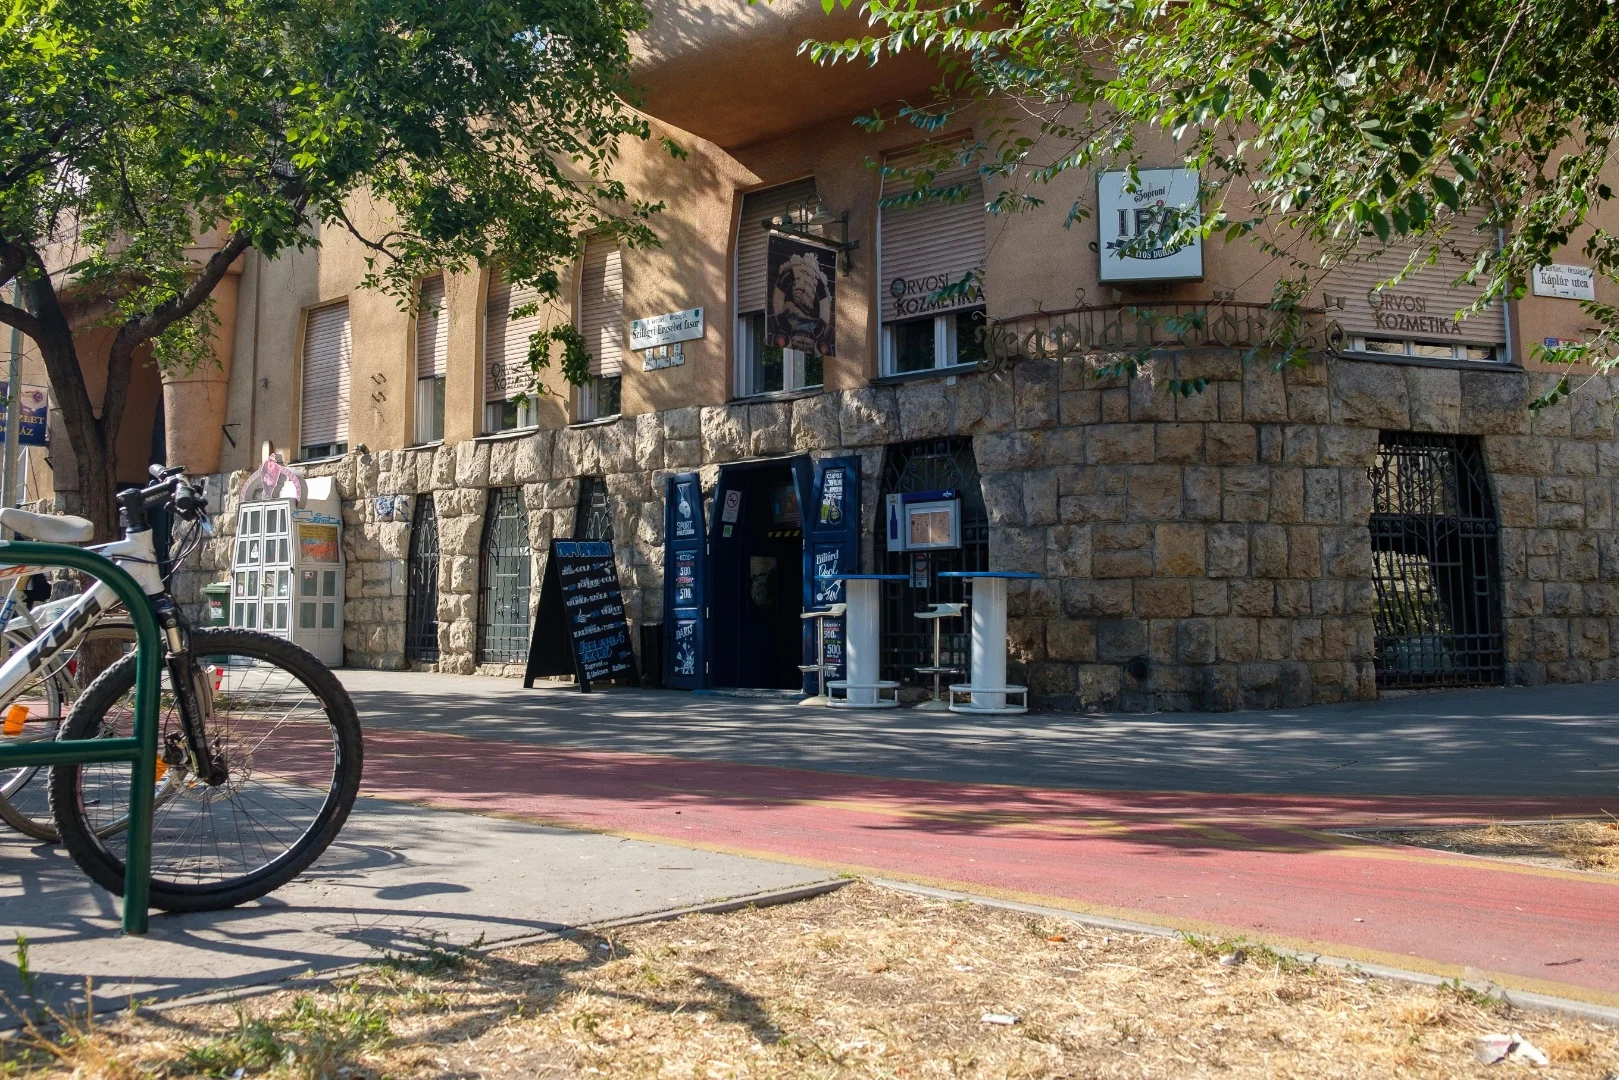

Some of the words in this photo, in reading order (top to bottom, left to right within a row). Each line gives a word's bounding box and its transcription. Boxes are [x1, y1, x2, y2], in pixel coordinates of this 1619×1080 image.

[1134, 186, 1166, 203] Soproni
[890, 273, 948, 298] ORVOSI
[1541, 273, 1569, 288] Káplár
[1572, 279, 1589, 288] utca
[894, 286, 985, 317] KOZMTIKA
[1367, 289, 1426, 312] ORVOSI
[632, 326, 656, 340] Szilágyi
[657, 321, 682, 335] Erzsébet
[684, 319, 700, 330] fasor
[1373, 312, 1462, 335] KOZMETIKA
[676, 521, 693, 530] SPORT
[676, 624, 693, 640] DARTS
